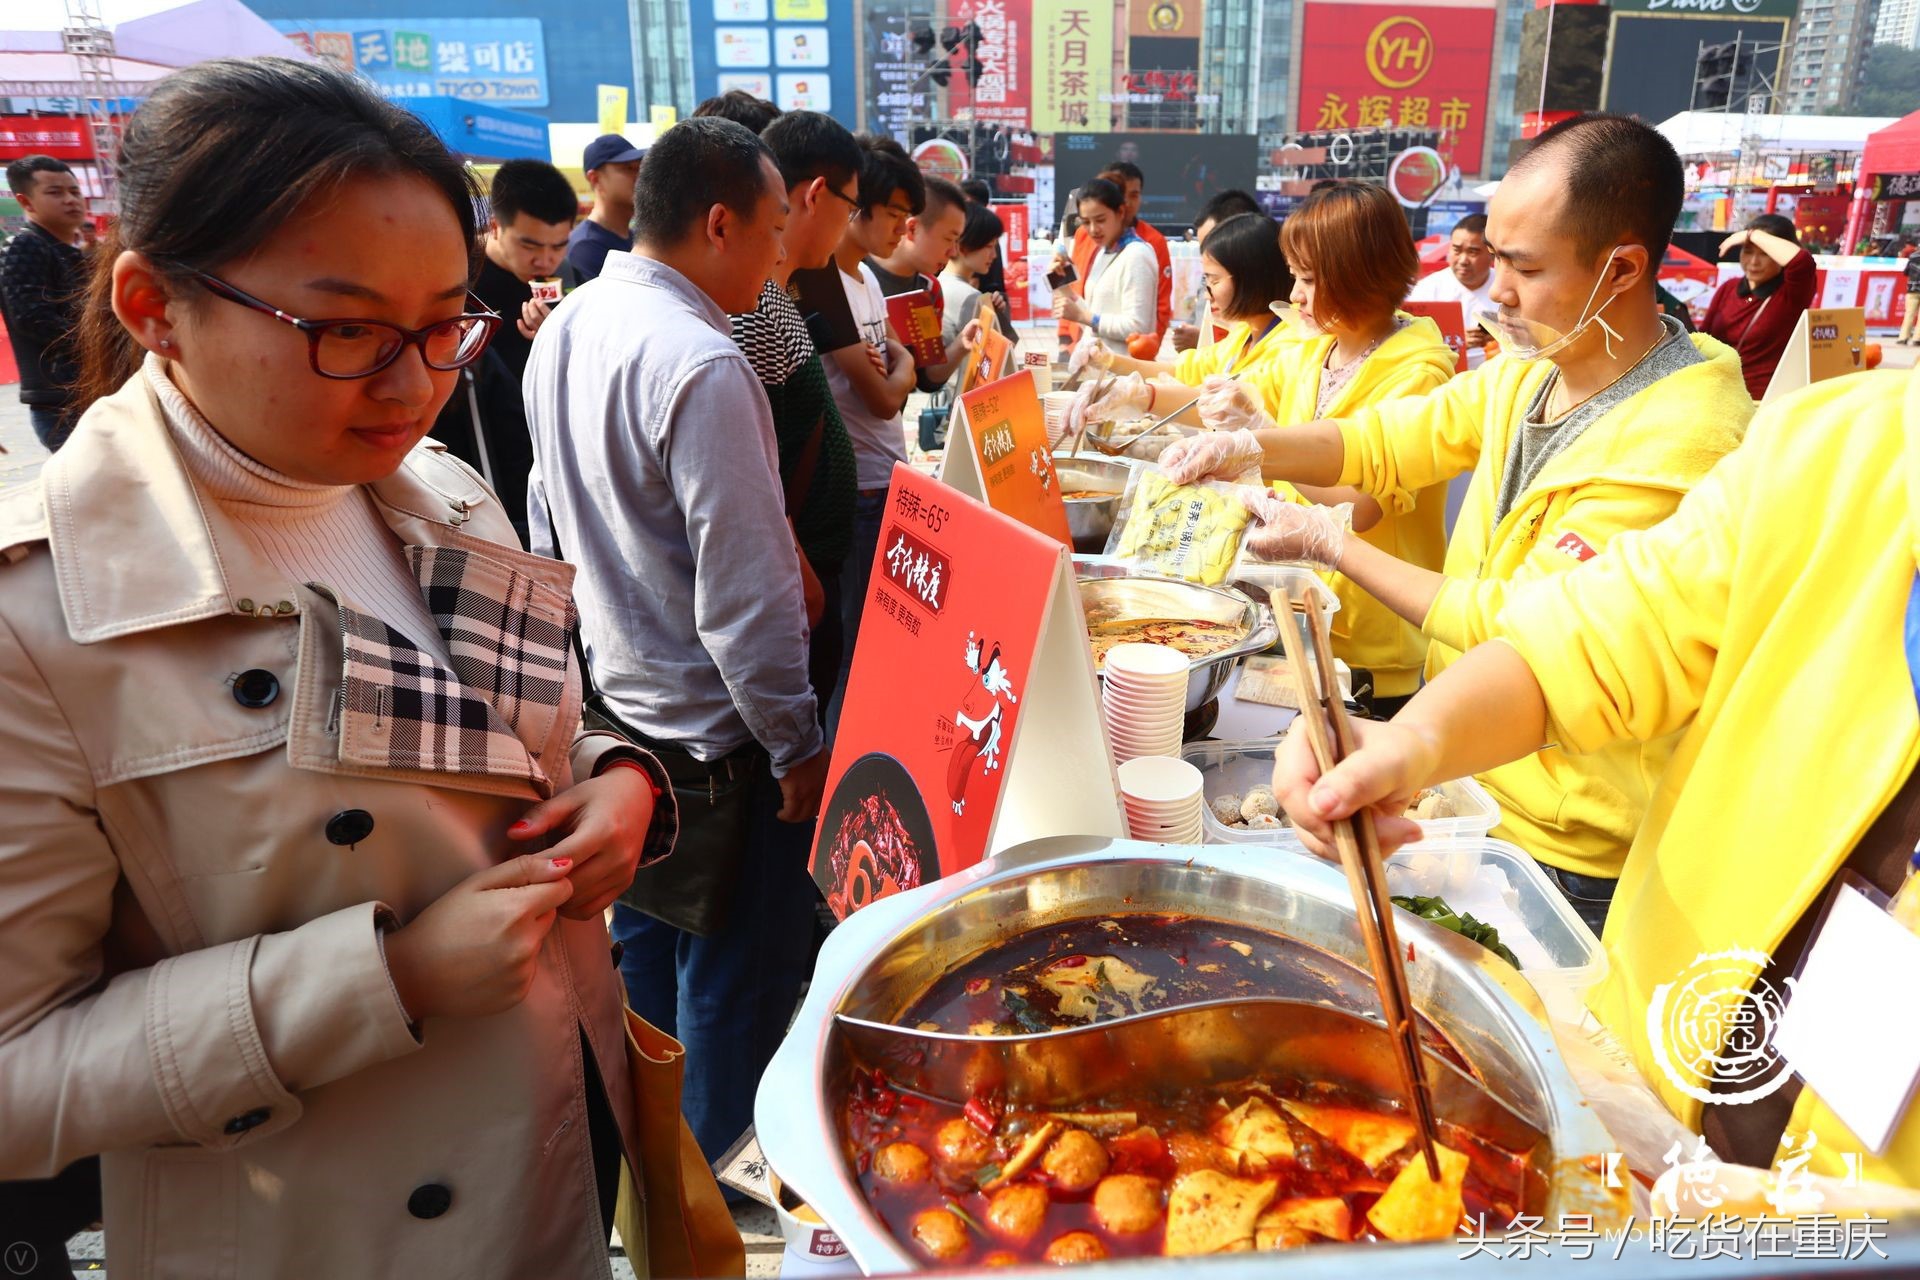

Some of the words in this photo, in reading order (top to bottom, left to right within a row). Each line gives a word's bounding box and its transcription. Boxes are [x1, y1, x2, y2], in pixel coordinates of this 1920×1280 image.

[1059, 10, 1091, 125] 天月茶城
[1379, 36, 1427, 69] YH
[437, 81, 487, 97] TICO
[489, 82, 540, 97] Town
[1316, 93, 1472, 130] 永辉超市
[895, 485, 950, 533] 特辣=65°
[886, 533, 942, 609] 李氏辣度
